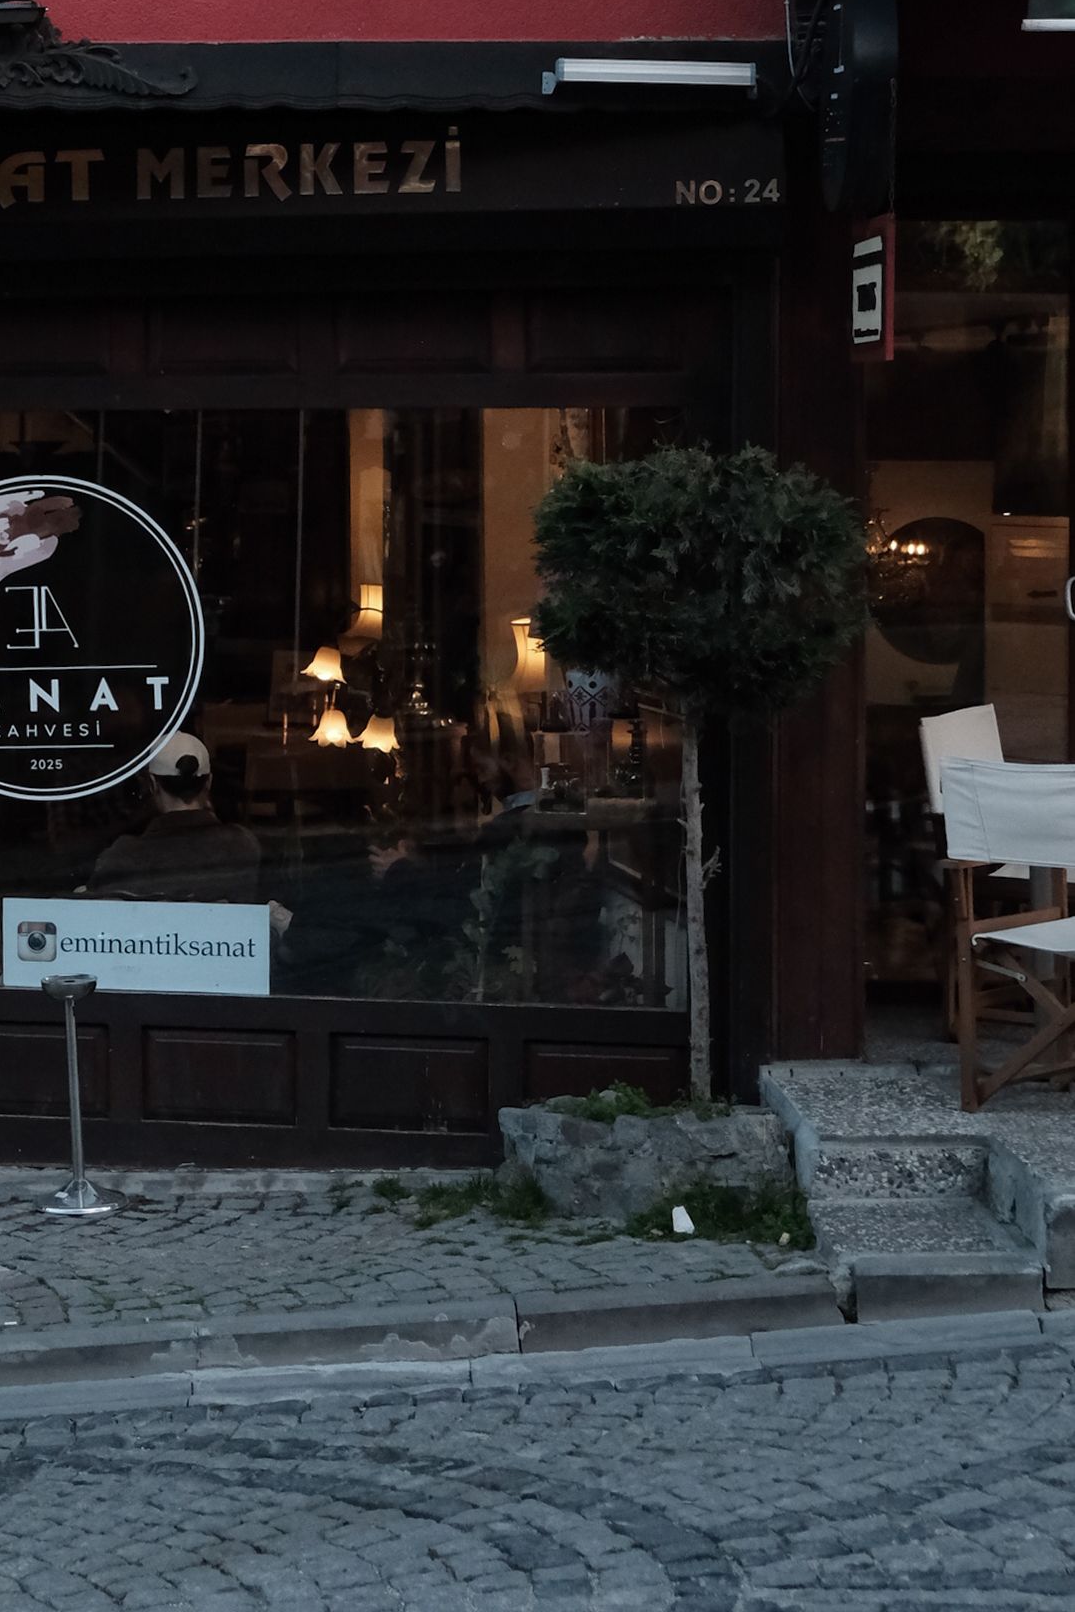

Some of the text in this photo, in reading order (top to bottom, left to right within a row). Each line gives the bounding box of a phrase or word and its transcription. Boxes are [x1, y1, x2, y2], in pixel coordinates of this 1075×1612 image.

[136, 126, 462, 203] MERKEZİ
[30, 759, 63, 770] 2025
[60, 931, 257, 958] eminantiksanat
